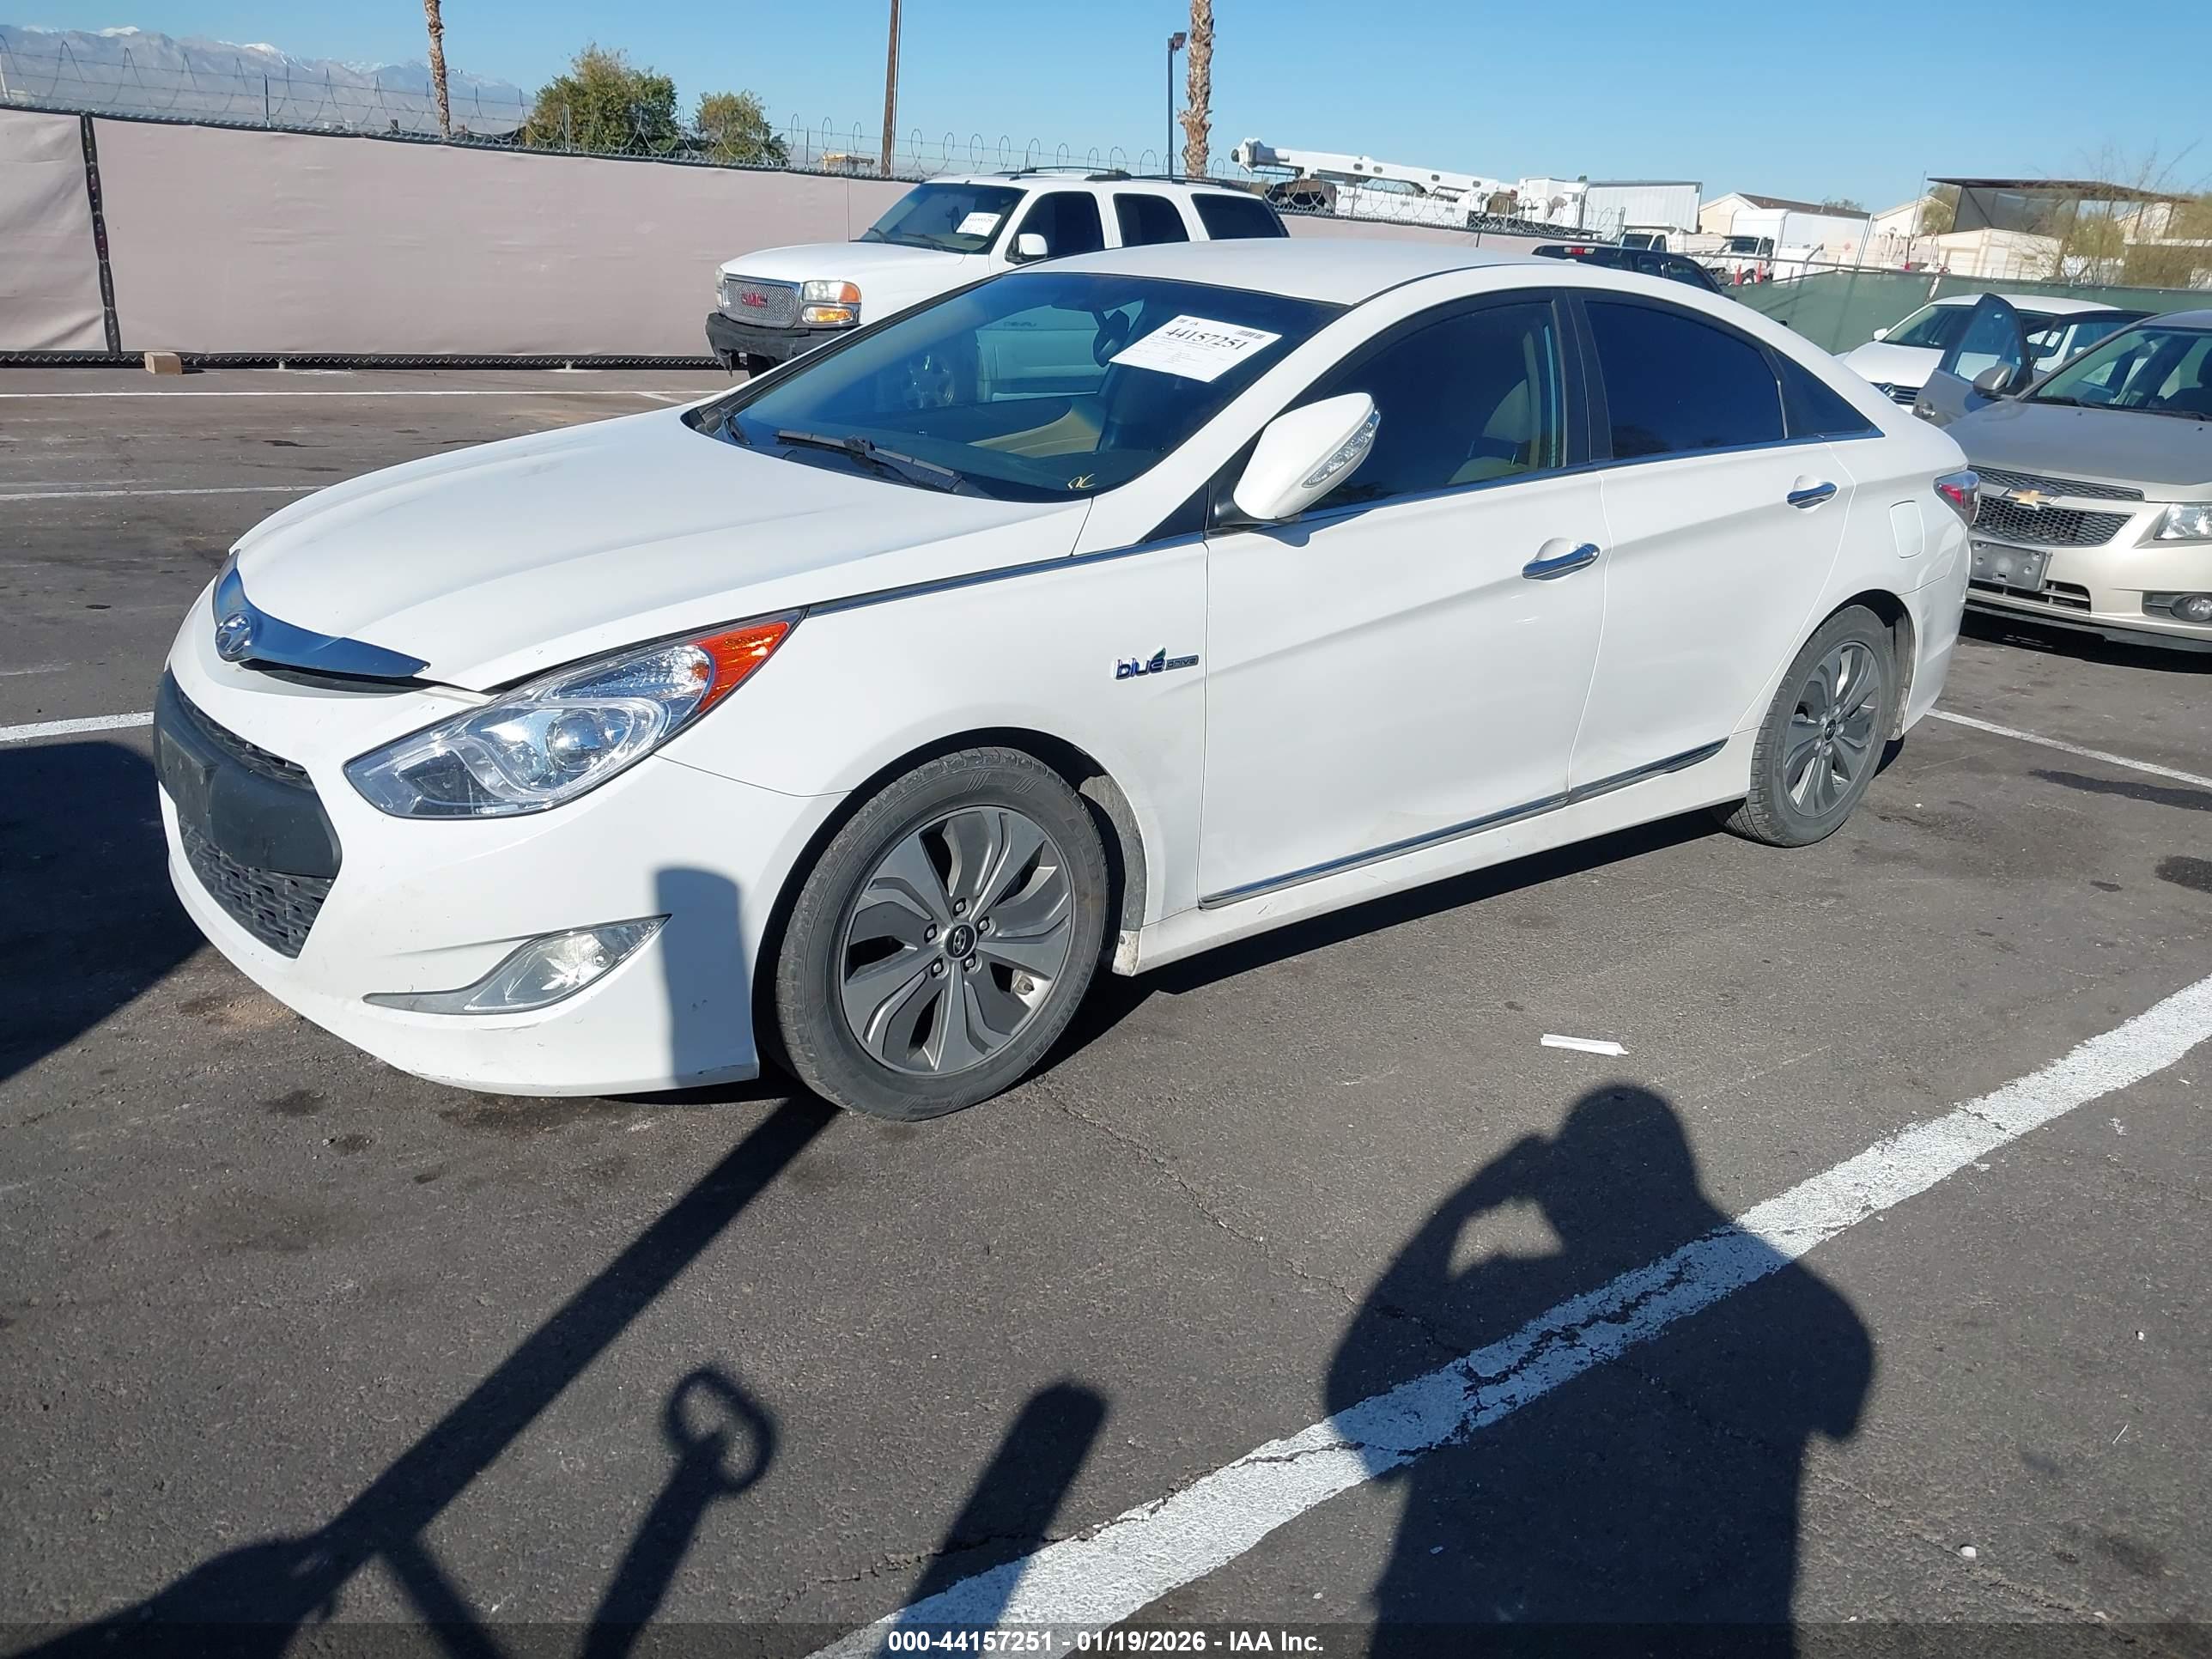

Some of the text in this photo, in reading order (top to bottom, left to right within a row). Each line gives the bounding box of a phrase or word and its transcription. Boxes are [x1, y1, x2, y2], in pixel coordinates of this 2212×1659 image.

[741, 292, 769, 309] GMC
[1164, 327, 1249, 350] 44157251
[1115, 656, 1165, 680] blue
